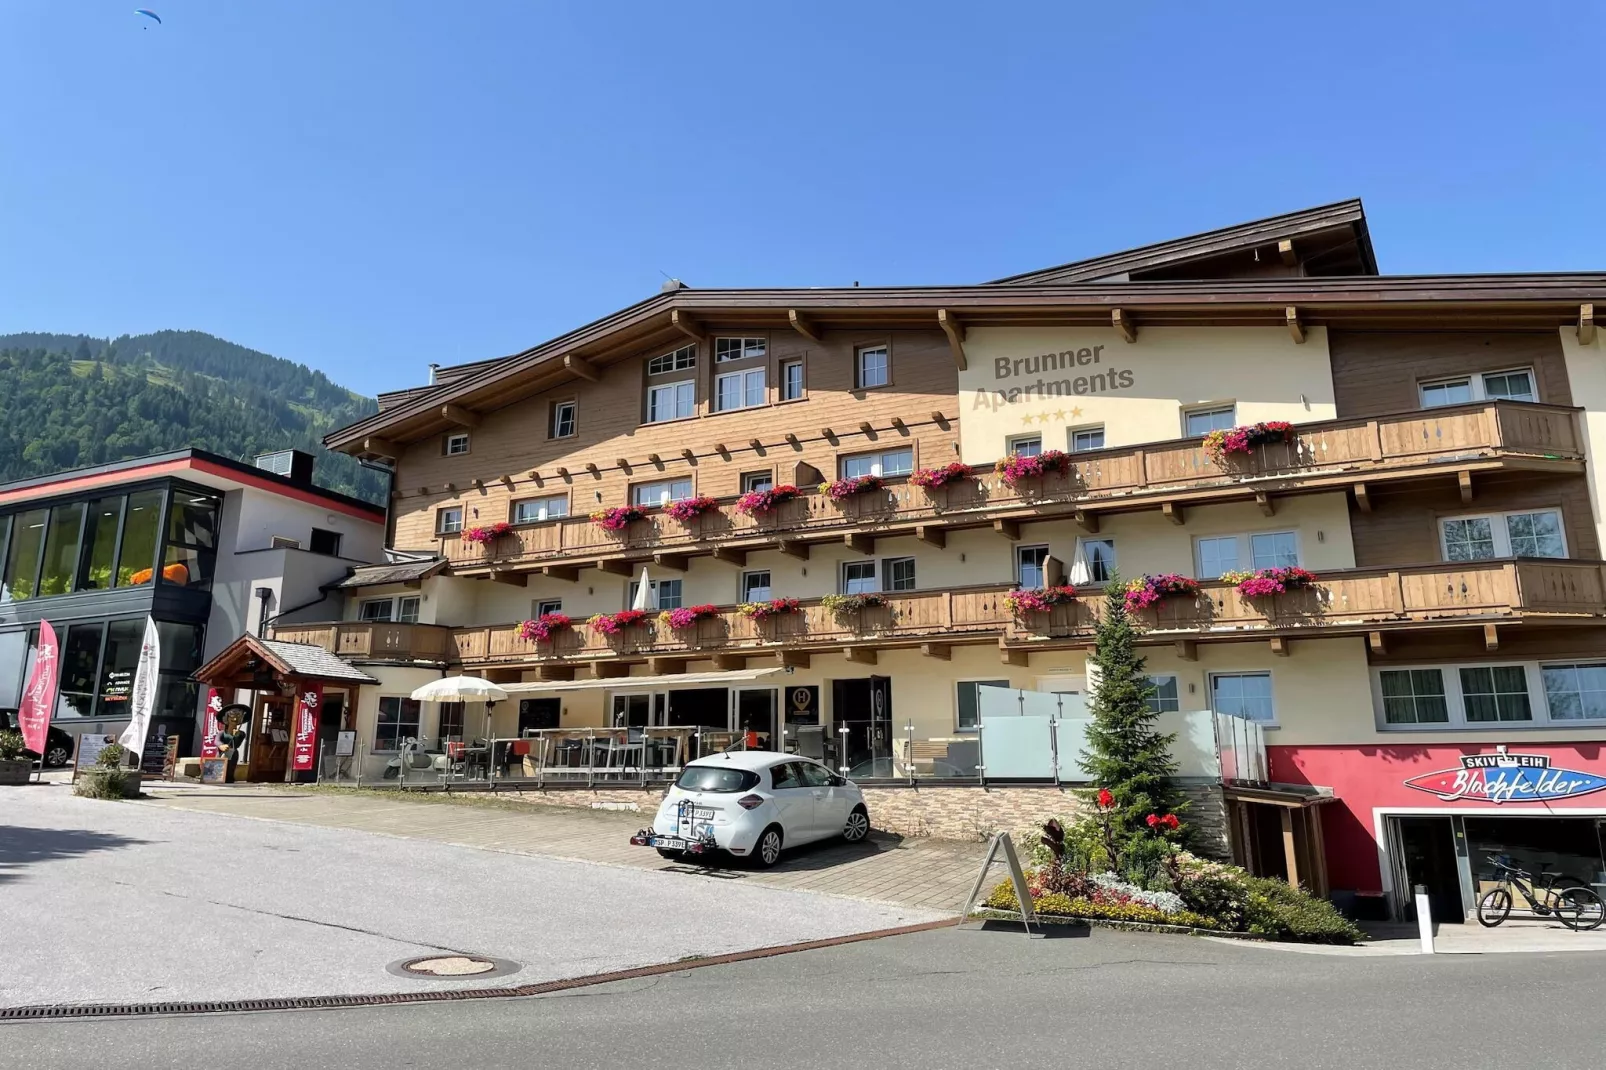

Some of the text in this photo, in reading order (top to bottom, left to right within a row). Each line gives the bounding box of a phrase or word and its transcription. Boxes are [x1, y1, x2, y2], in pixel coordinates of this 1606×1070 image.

[994, 344, 1105, 380] Brunner
[972, 367, 1135, 413] Apartments
[1440, 770, 1584, 803] Blachfelder
